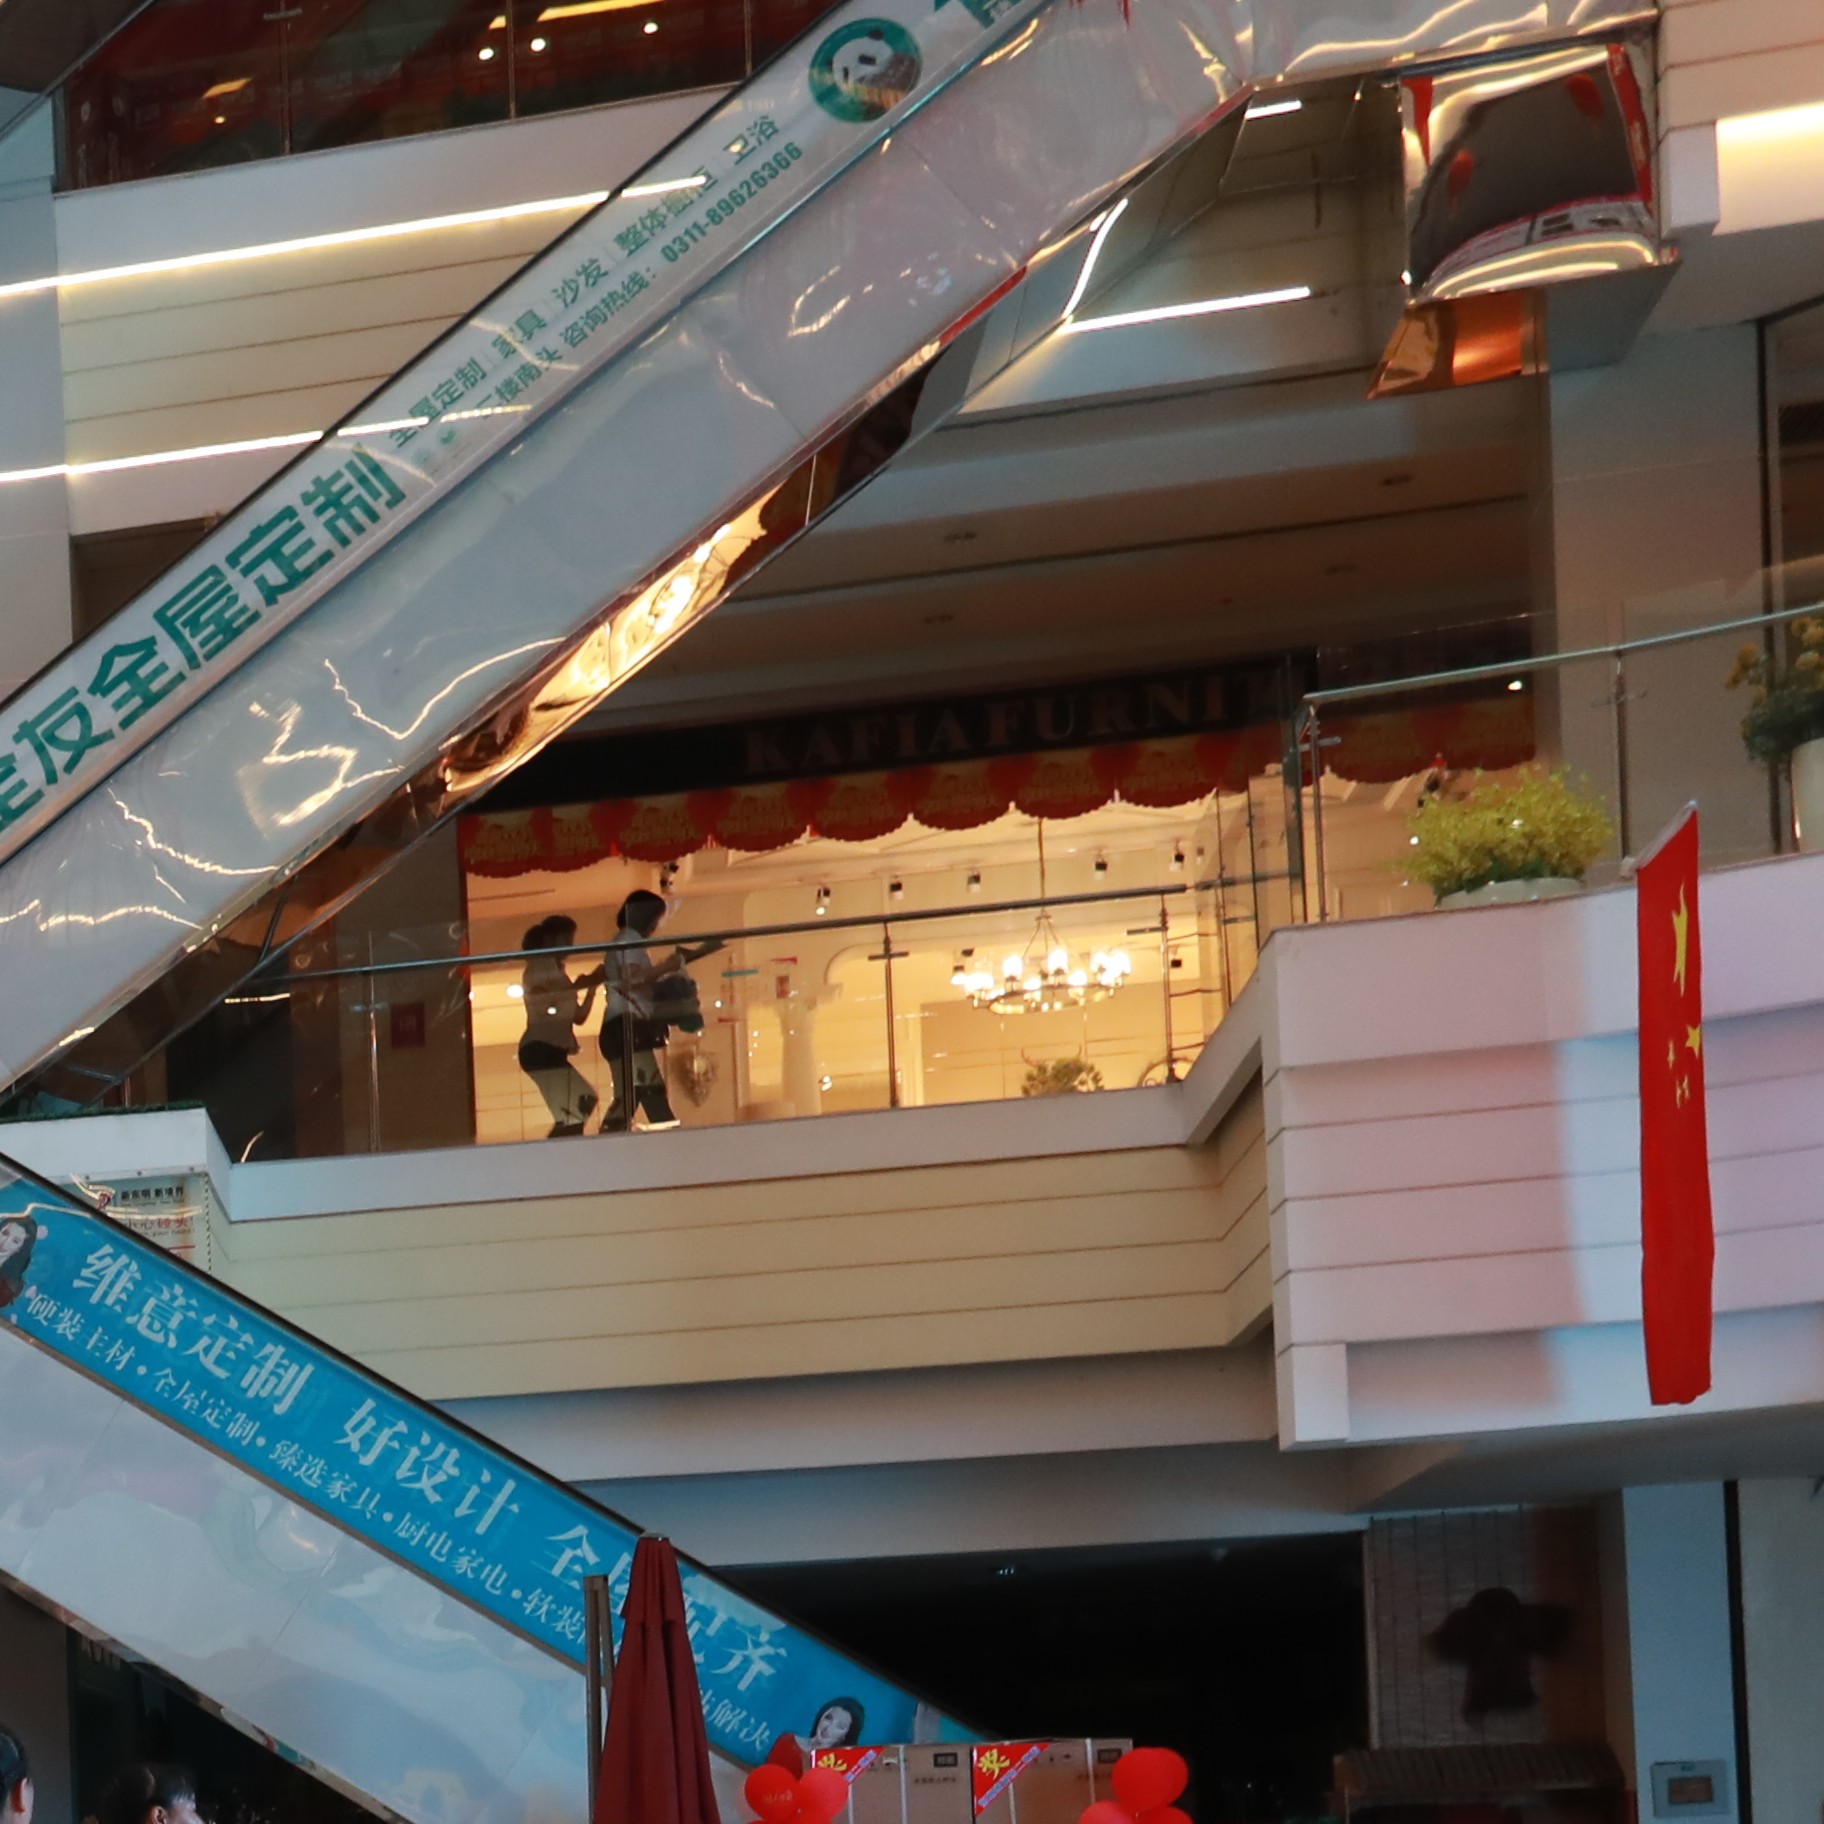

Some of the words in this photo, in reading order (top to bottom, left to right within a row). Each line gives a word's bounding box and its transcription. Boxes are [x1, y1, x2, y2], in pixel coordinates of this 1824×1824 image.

[73, 1244, 315, 1416] 维意定制
[334, 1396, 521, 1535] 好设计
